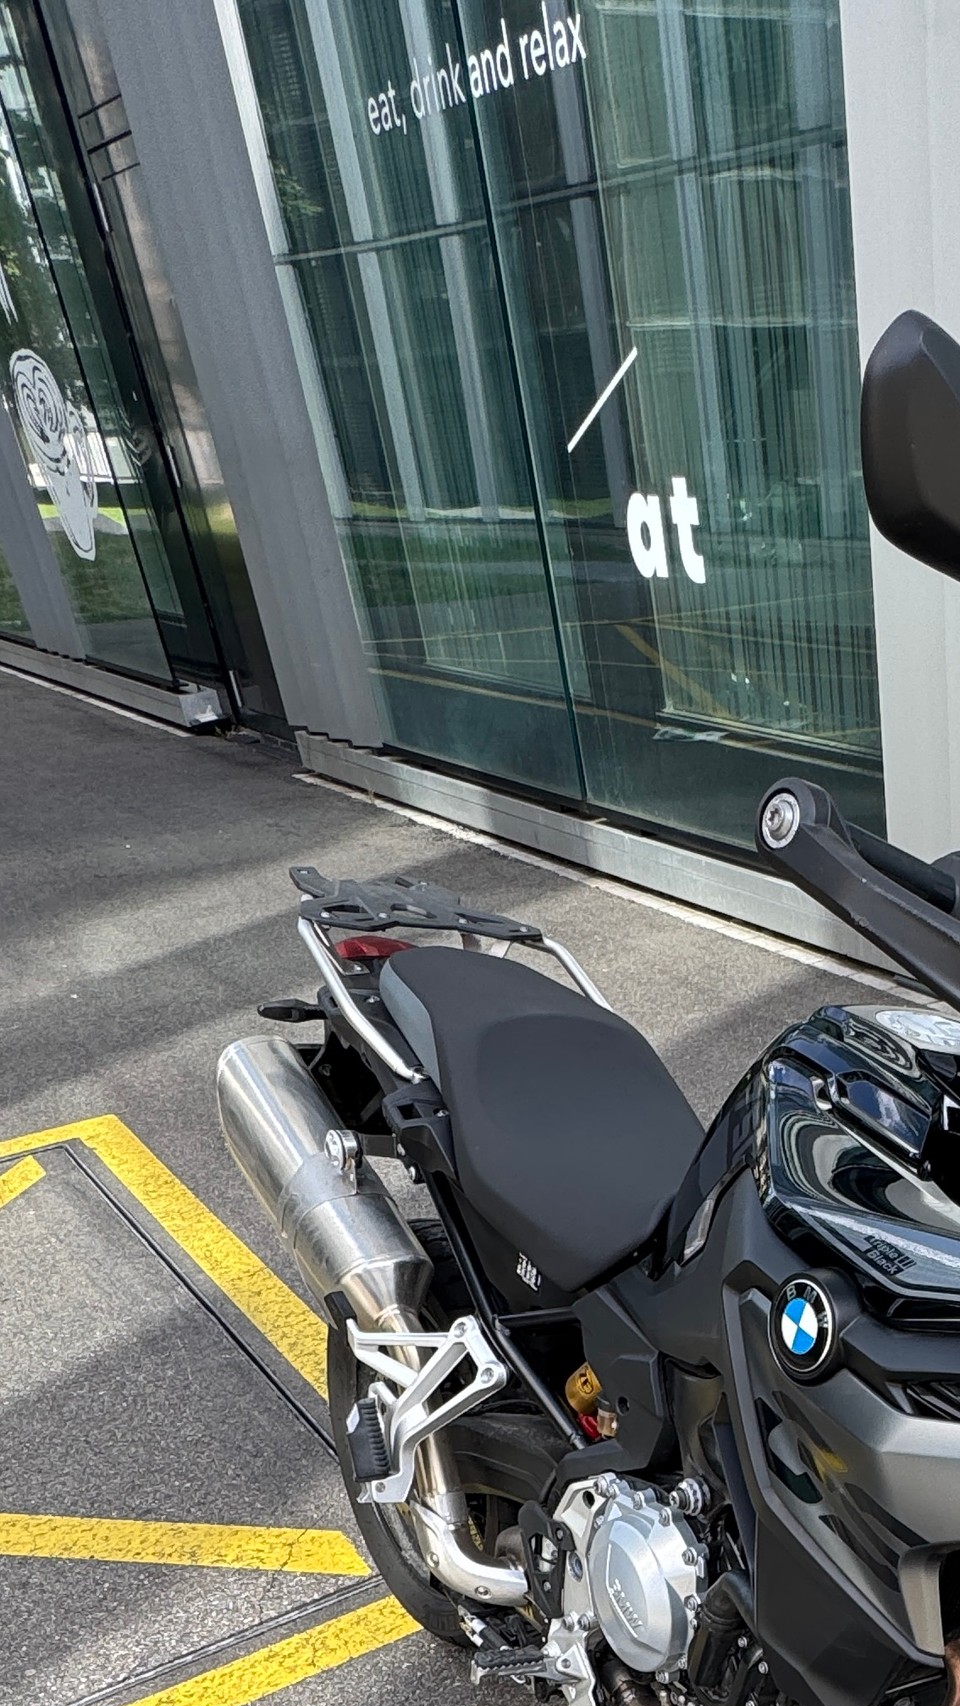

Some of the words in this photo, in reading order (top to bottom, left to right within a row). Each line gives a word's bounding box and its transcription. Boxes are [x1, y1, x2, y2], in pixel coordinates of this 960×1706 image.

[367, 79, 407, 136] eat,
[410, 43, 467, 120] drink
[468, 17, 515, 99] and
[519, 0, 587, 80] relax
[626, 477, 707, 585] at
[865, 1249, 898, 1275] Black
